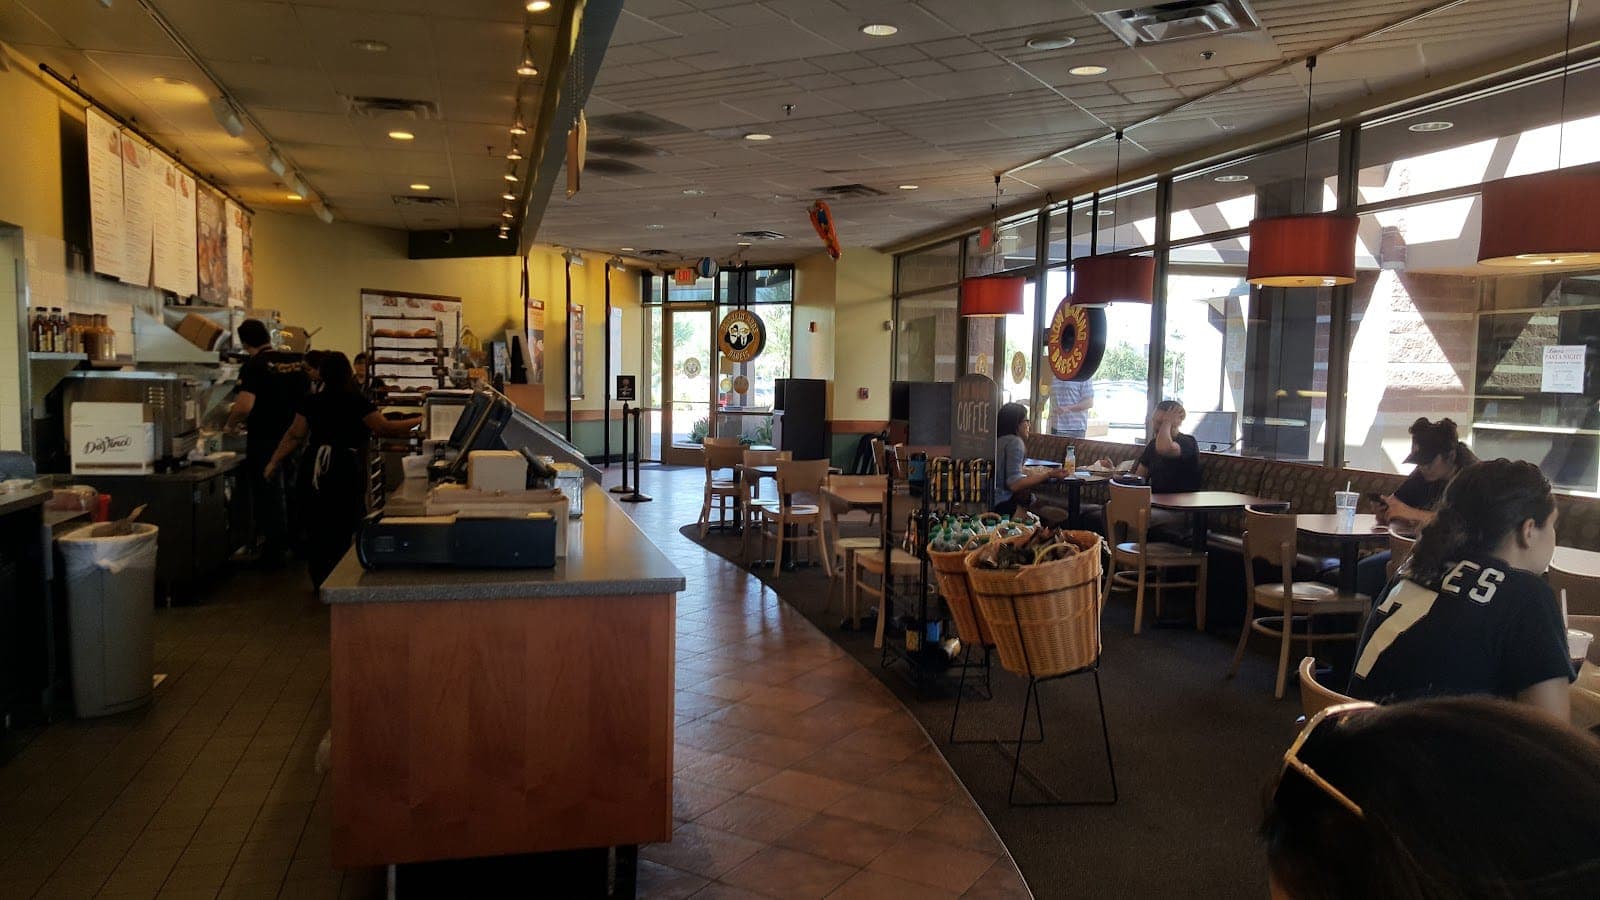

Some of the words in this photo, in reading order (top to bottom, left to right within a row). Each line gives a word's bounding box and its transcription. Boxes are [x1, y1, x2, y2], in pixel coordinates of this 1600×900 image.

[1051, 347, 1083, 375] BAGELS
[957, 401, 990, 434] COFFEE
[1441, 560, 1506, 604] ES
